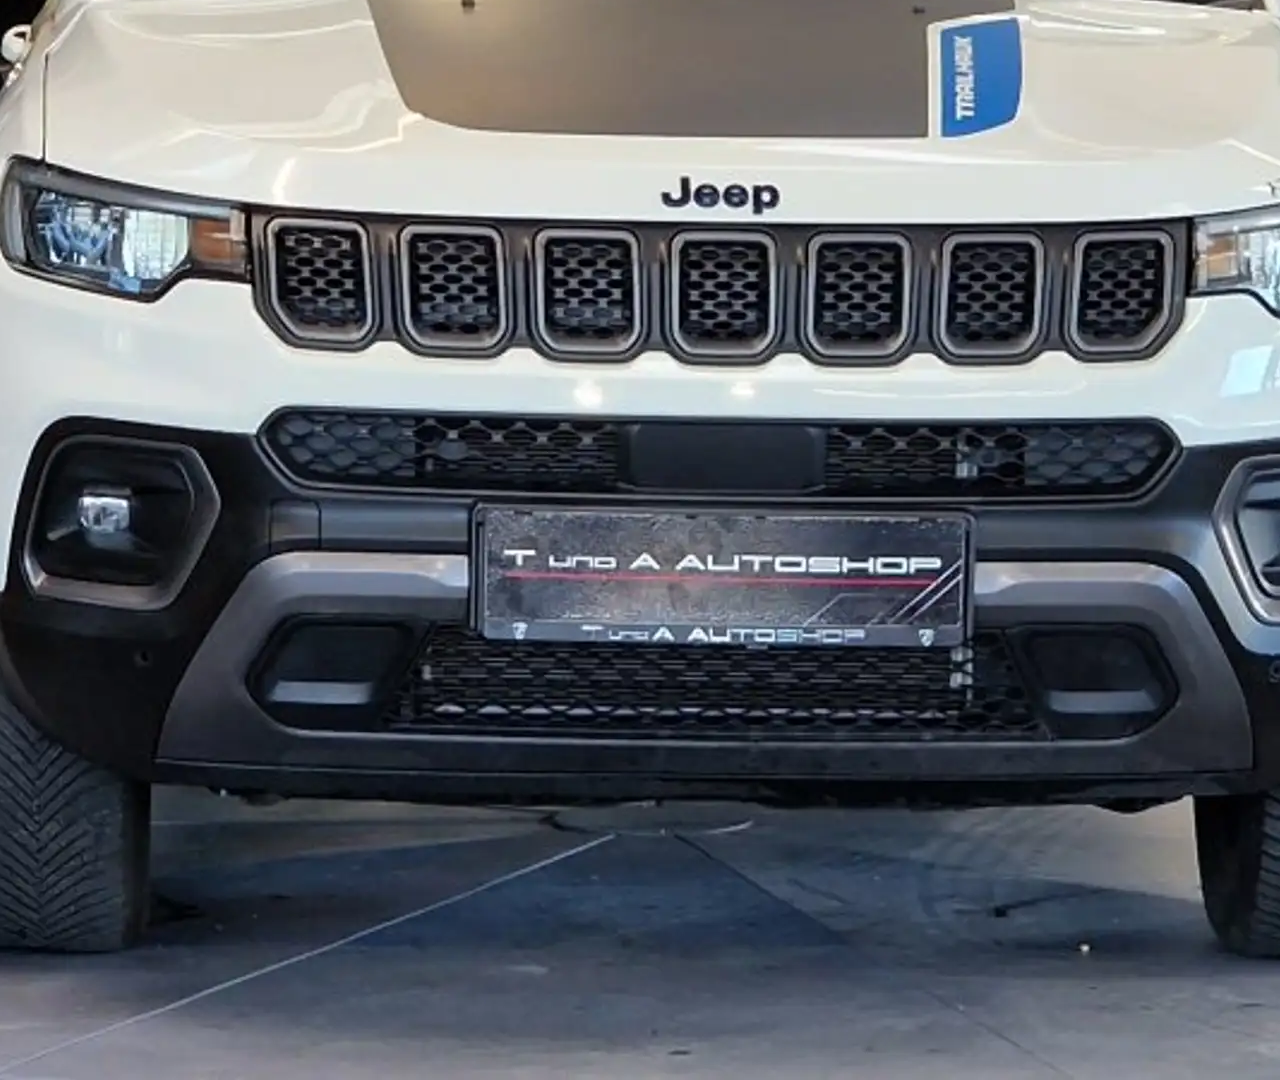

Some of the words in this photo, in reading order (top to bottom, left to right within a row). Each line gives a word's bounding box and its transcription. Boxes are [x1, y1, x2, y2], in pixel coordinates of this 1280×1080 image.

[660, 176, 780, 215] Jeep
[503, 548, 537, 566] T
[628, 552, 661, 571] A
[675, 553, 942, 577] AUTOSHOP
